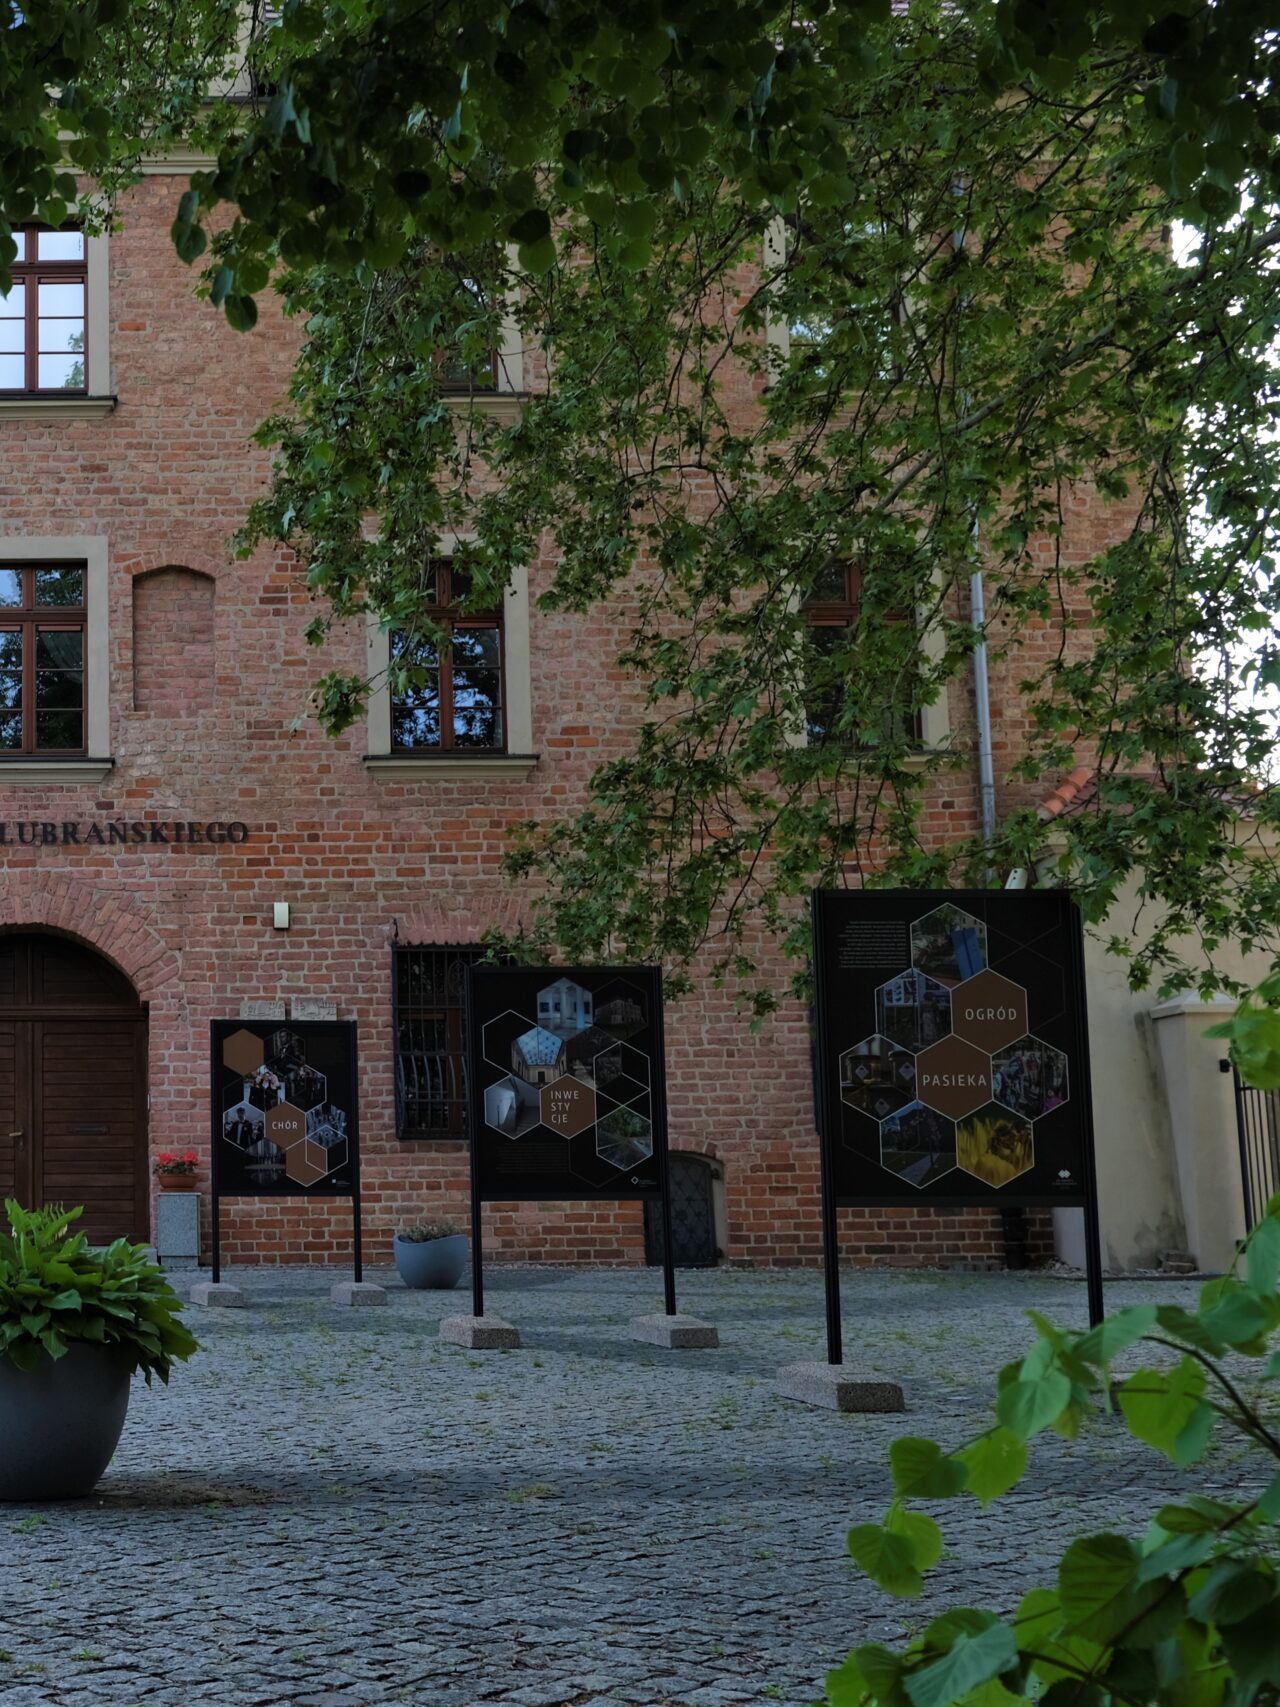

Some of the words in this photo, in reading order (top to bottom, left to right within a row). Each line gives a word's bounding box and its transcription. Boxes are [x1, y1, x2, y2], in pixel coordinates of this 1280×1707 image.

[965, 1006, 1017, 1020] OGRÓD
[922, 1074, 987, 1087] PASIEKA
[550, 1090, 580, 1100] INWE
[551, 1102, 570, 1112] STY
[551, 1113, 568, 1125] CJE
[271, 1120, 298, 1130] CHÓR
